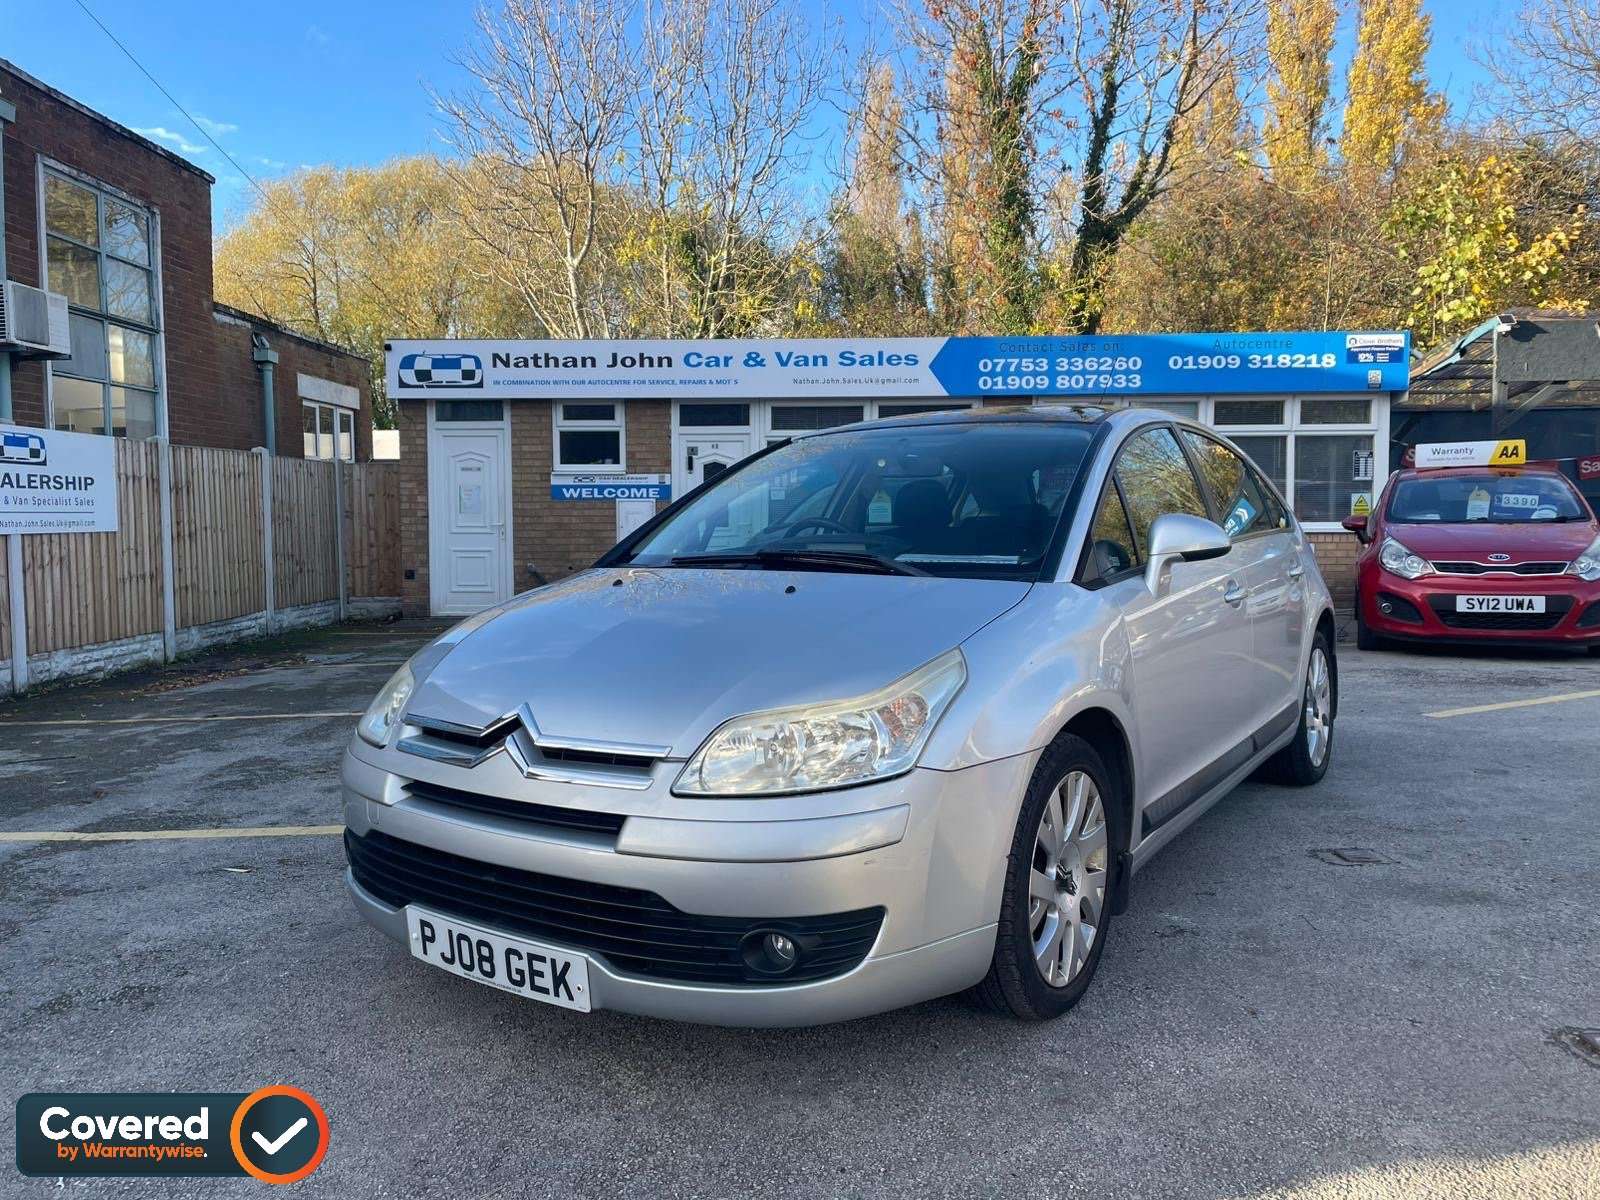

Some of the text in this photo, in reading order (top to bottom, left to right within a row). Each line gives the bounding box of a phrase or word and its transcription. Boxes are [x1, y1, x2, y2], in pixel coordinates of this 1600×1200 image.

[999, 342, 1053, 353] Contact
[1060, 341, 1096, 352] Sales
[1213, 338, 1293, 350] Autocentre
[492, 350, 919, 368] Nathan John Car & Van Sales
[978, 356, 1142, 372] 07753 336260
[1168, 353, 1336, 369] 01909 318218
[978, 374, 1142, 390] 01909 807933
[1431, 445, 1519, 458] Warranty AA
[0, 472, 95, 491] ALERSHIP
[562, 487, 660, 498] WELCOME
[4, 495, 95, 507] & Van Specialist Sales
[1466, 598, 1534, 611] SY12 UWA
[419, 918, 575, 1002] PJ08 GEK
